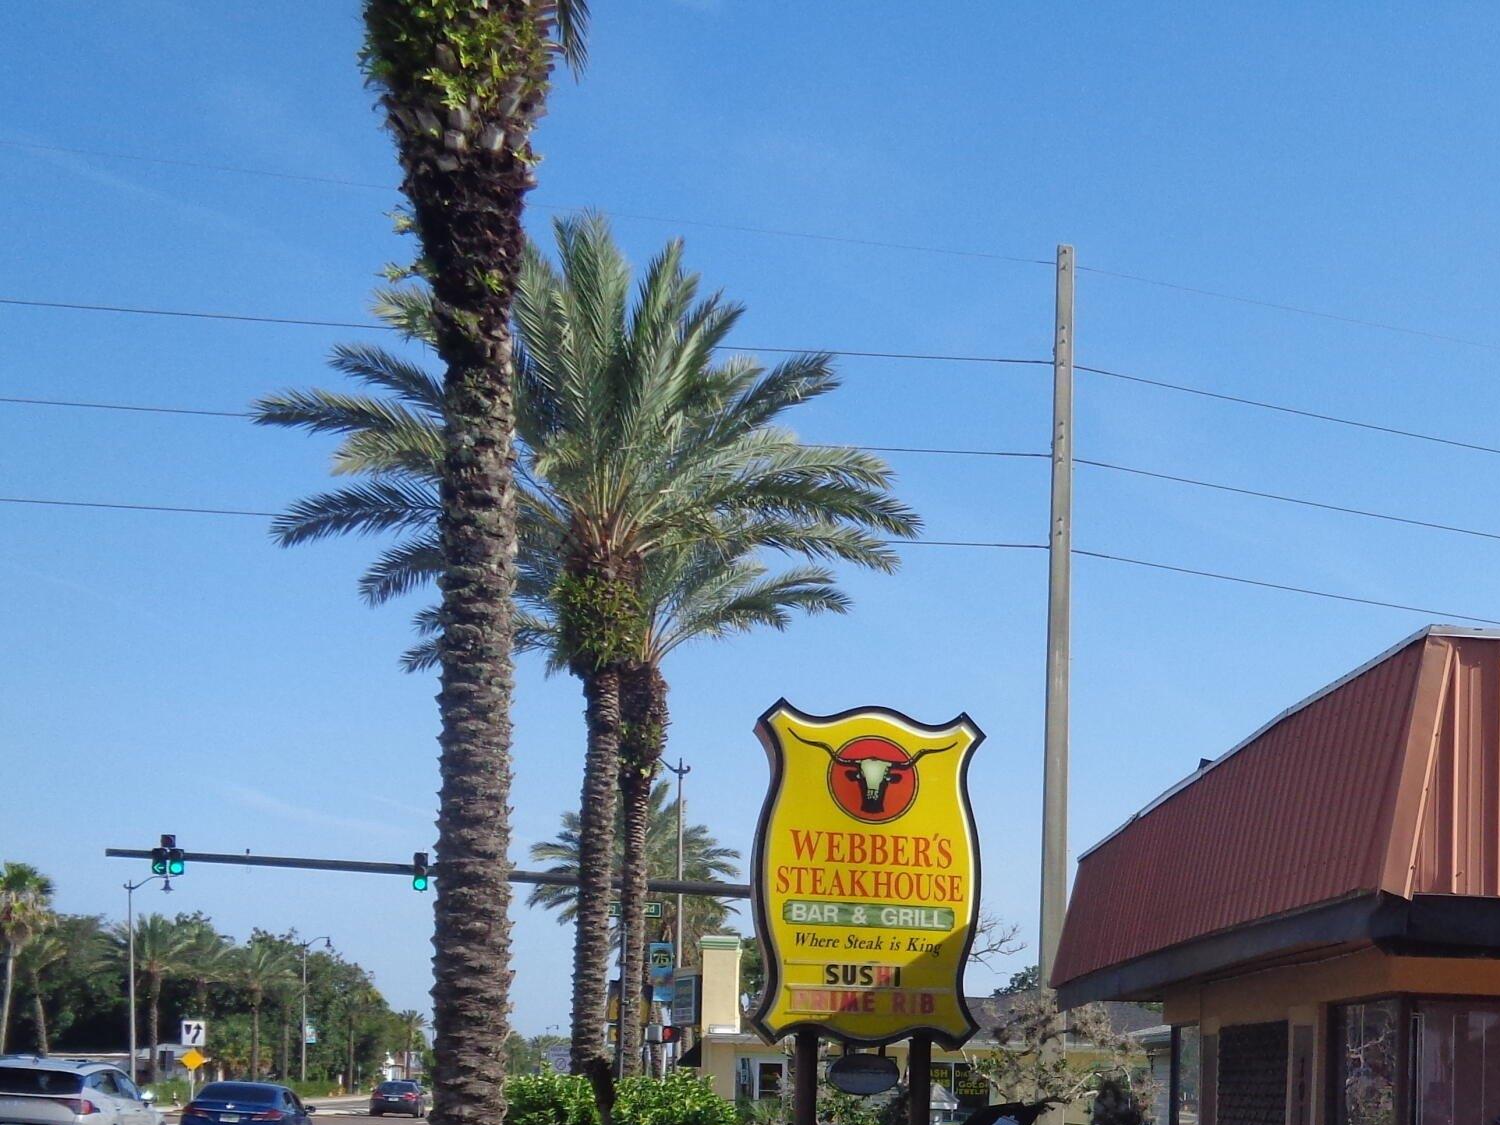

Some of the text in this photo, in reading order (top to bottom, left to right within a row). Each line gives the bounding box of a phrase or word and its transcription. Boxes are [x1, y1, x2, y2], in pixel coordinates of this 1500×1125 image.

[790, 829, 953, 869] WEBBER'S
[776, 865, 964, 902] STEAKHOUSE
[791, 903, 946, 928] BAR & GRILL
[795, 932, 943, 958] Where Steak is King
[825, 963, 901, 987] SUSHI
[892, 992, 935, 1014] RIB
